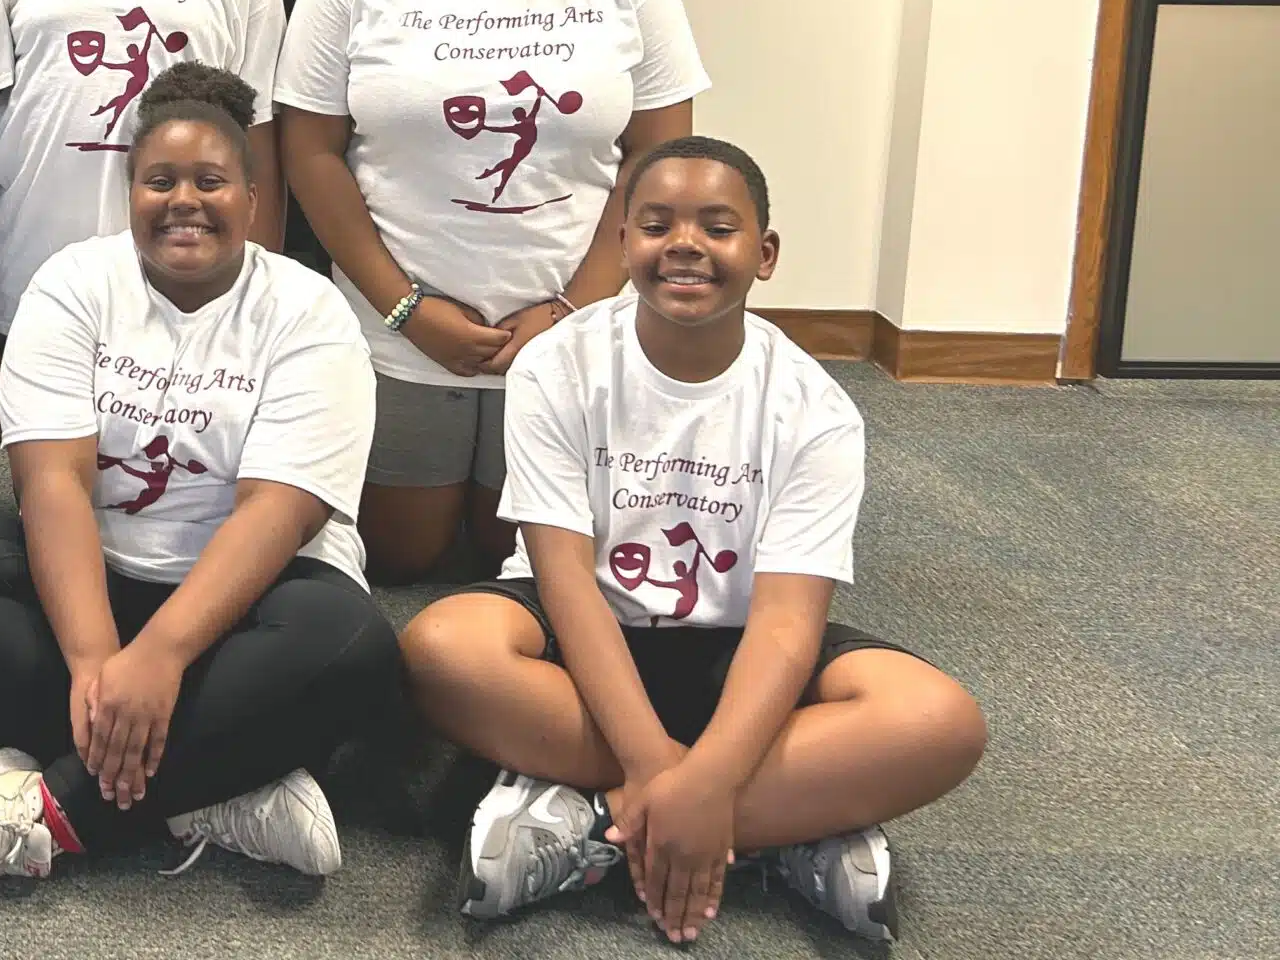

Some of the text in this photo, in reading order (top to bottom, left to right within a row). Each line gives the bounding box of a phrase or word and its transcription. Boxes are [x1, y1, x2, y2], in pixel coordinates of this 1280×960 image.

[398, 6, 605, 36] The Performing Arts
[433, 41, 576, 63] Conservatory
[203, 368, 257, 393] Arts
[97, 391, 213, 434] Conseraory
[619, 451, 731, 487] Performing
[612, 487, 743, 523] Conservatory
